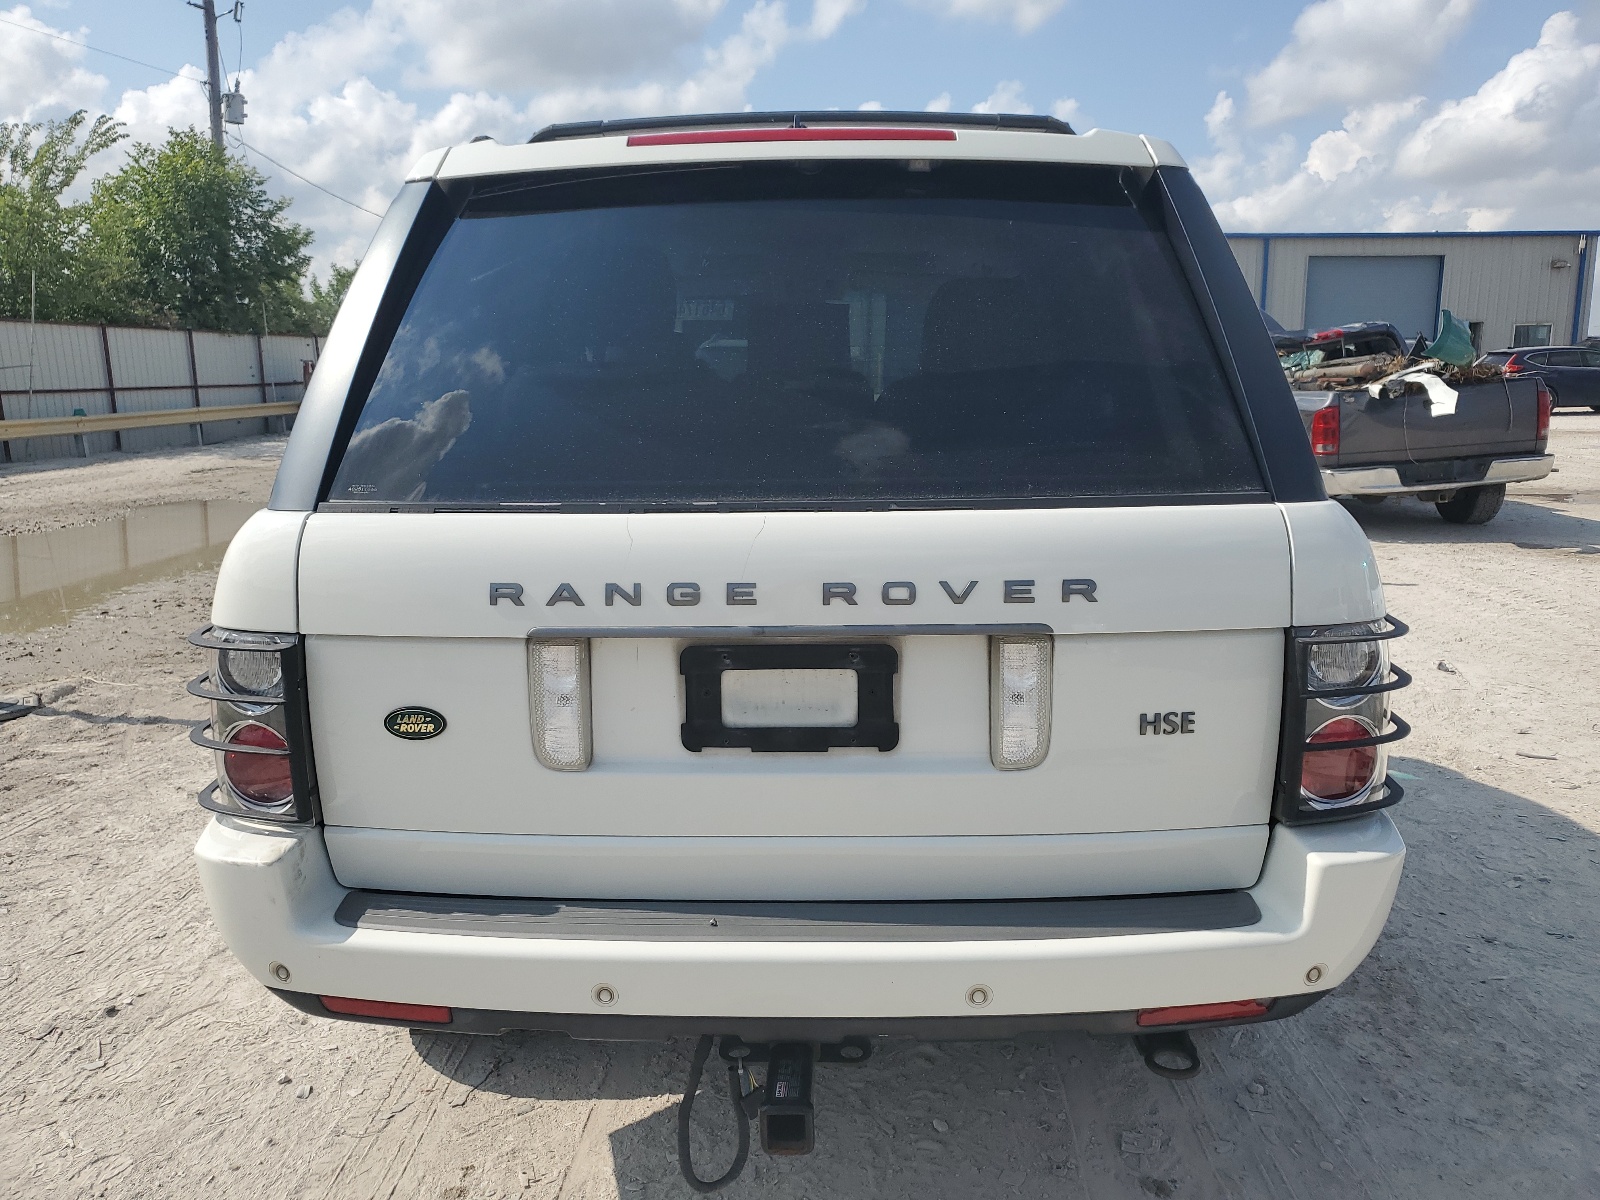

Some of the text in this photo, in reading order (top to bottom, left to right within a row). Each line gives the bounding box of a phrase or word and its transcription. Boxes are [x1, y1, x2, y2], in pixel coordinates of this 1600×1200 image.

[489, 578, 1099, 607] RANGE ROVER
[396, 714, 425, 724] LAND
[1139, 711, 1196, 735] HSE
[399, 723, 435, 733] ROVER
